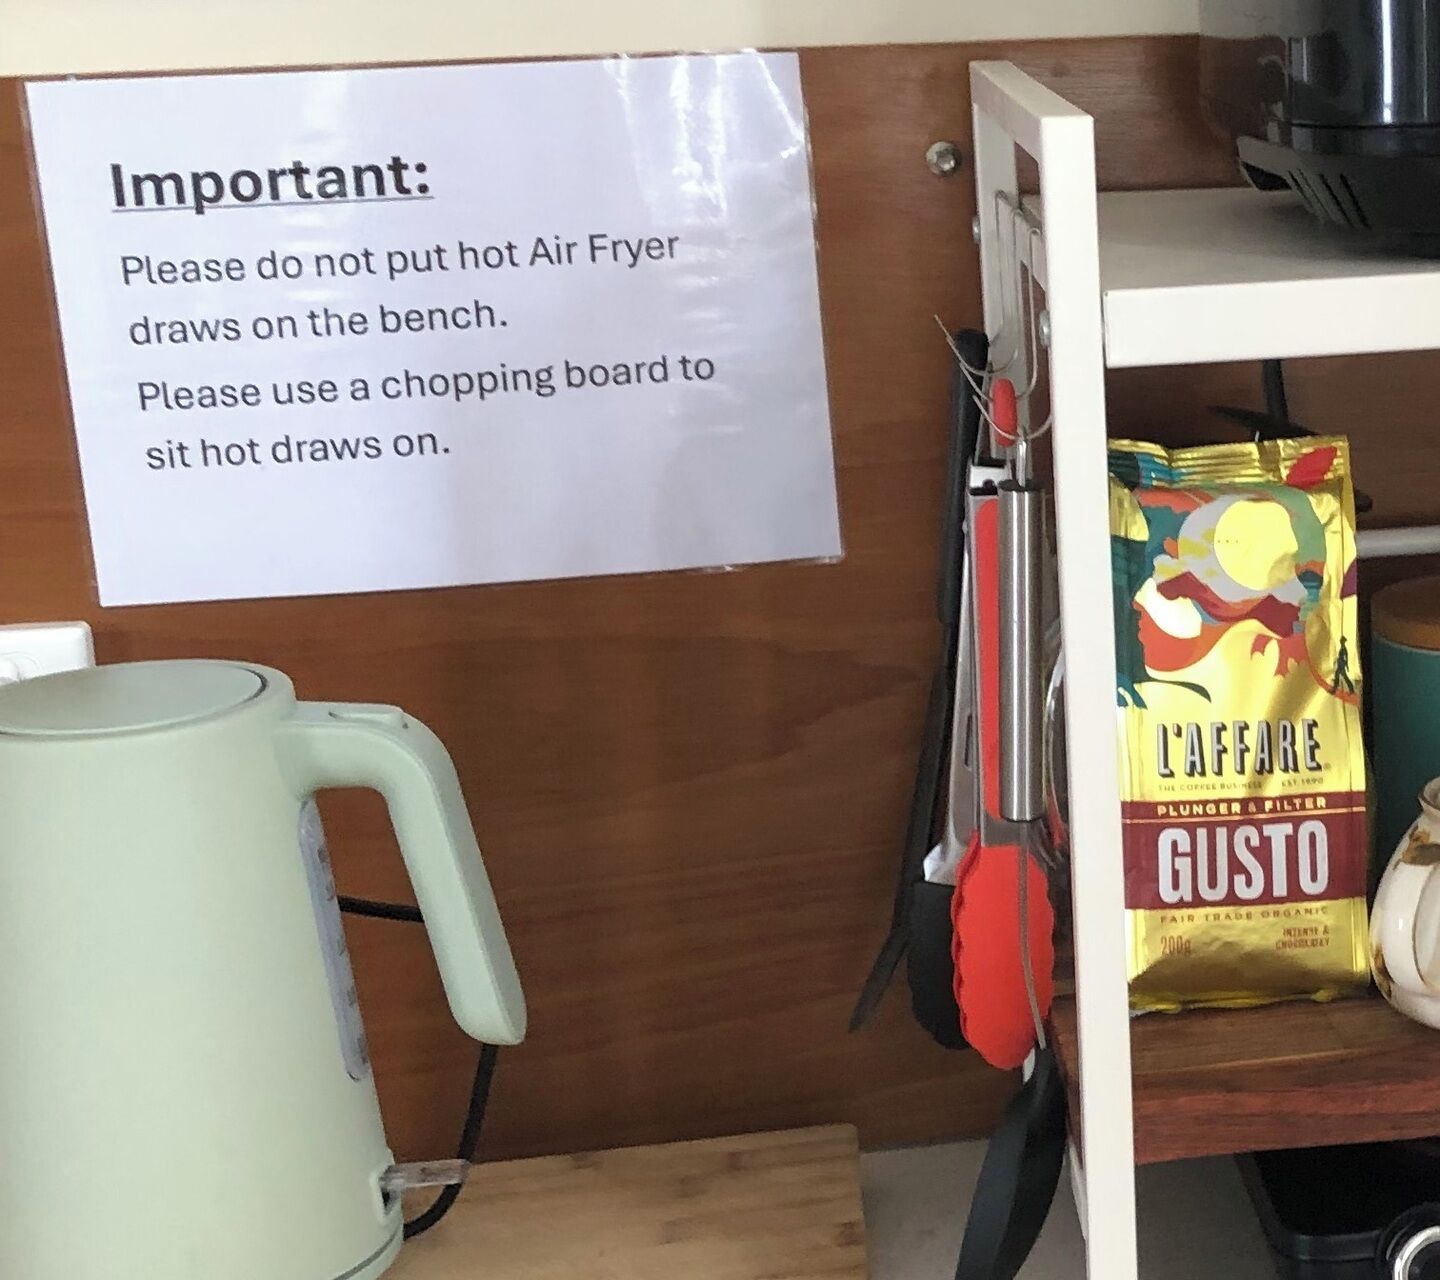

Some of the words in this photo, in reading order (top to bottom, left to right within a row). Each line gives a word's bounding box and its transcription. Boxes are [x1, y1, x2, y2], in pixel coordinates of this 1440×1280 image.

[110, 156, 431, 215] Important:
[120, 255, 246, 286] Please
[256, 250, 303, 280] do
[314, 248, 377, 277] not
[386, 244, 449, 281] put
[458, 240, 520, 270] hot
[528, 235, 578, 267] Air
[588, 233, 680, 269] Fryer
[129, 316, 242, 346] draws
[252, 314, 298, 340] on
[307, 308, 369, 337] the
[379, 299, 508, 334] bench.
[138, 380, 261, 411] Please
[272, 379, 339, 405] use
[350, 377, 370, 401] a
[381, 362, 557, 402] chopping
[564, 354, 670, 389] board
[678, 354, 715, 381] to
[146, 439, 192, 471] sit
[200, 435, 262, 467] hot
[271, 434, 382, 464] draws
[392, 431, 450, 458] on.
[1157, 718, 1322, 778] L'AFFARE
[1157, 802, 1241, 817] PLUNGER
[1264, 796, 1327, 813] FILTER
[1157, 819, 1330, 904] GUSTO
[1260, 906, 1329, 920] ORGANIC
